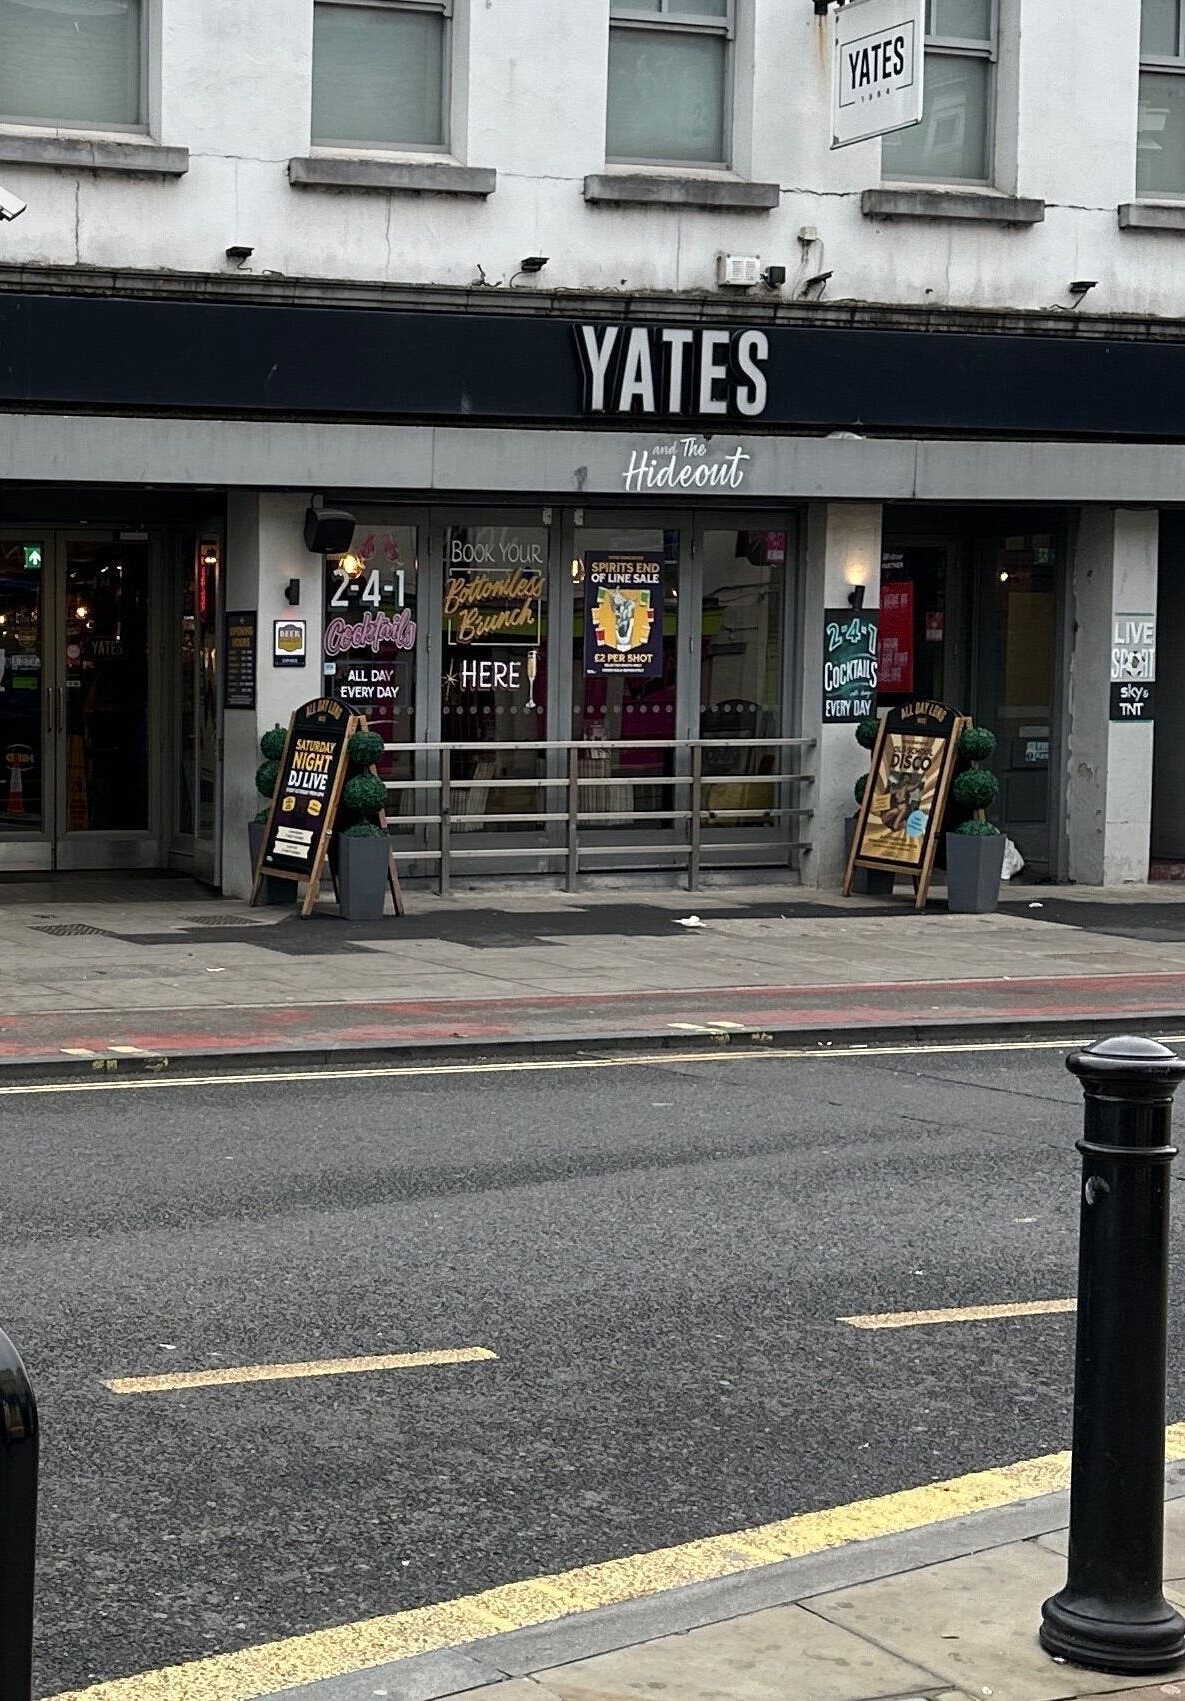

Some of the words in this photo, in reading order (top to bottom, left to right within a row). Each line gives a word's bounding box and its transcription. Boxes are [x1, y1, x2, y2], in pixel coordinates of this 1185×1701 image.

[849, 35, 905, 90] YATES
[581, 325, 769, 417] YATES
[652, 441, 678, 456] and
[680, 436, 707, 457] The
[622, 446, 751, 493] Hideout
[451, 540, 496, 563] BOOK
[497, 543, 543, 564] YOUR
[590, 573, 606, 584] OF
[607, 573, 632, 584] LINE
[633, 573, 660, 584] SALE
[591, 562, 634, 574] SPIRITS
[635, 563, 661, 574] END
[330, 568, 405, 608] 2-4-1
[444, 567, 547, 614] Bottomless
[323, 607, 417, 657] Cocktails
[457, 598, 536, 644] Brunch
[1115, 621, 1155, 645] LIVE
[594, 653, 606, 663] £2
[607, 653, 626, 663] PER
[627, 653, 654, 663] SHOT
[347, 669, 368, 682] ALL
[371, 669, 395, 682] DAY
[461, 659, 522, 689] HERE
[824, 659, 878, 692] COCKTAILS
[340, 686, 375, 699] EVERY
[376, 686, 400, 699] DAY
[825, 699, 852, 717] EVERY
[853, 699, 872, 717] DAY
[1119, 702, 1145, 716] TNT
[295, 738, 337, 755] SATURDAY
[291, 751, 334, 774] NIGHT
[891, 753, 933, 771] DISCO
[287, 769, 304, 788] DJ
[302, 771, 329, 790] LIVE
